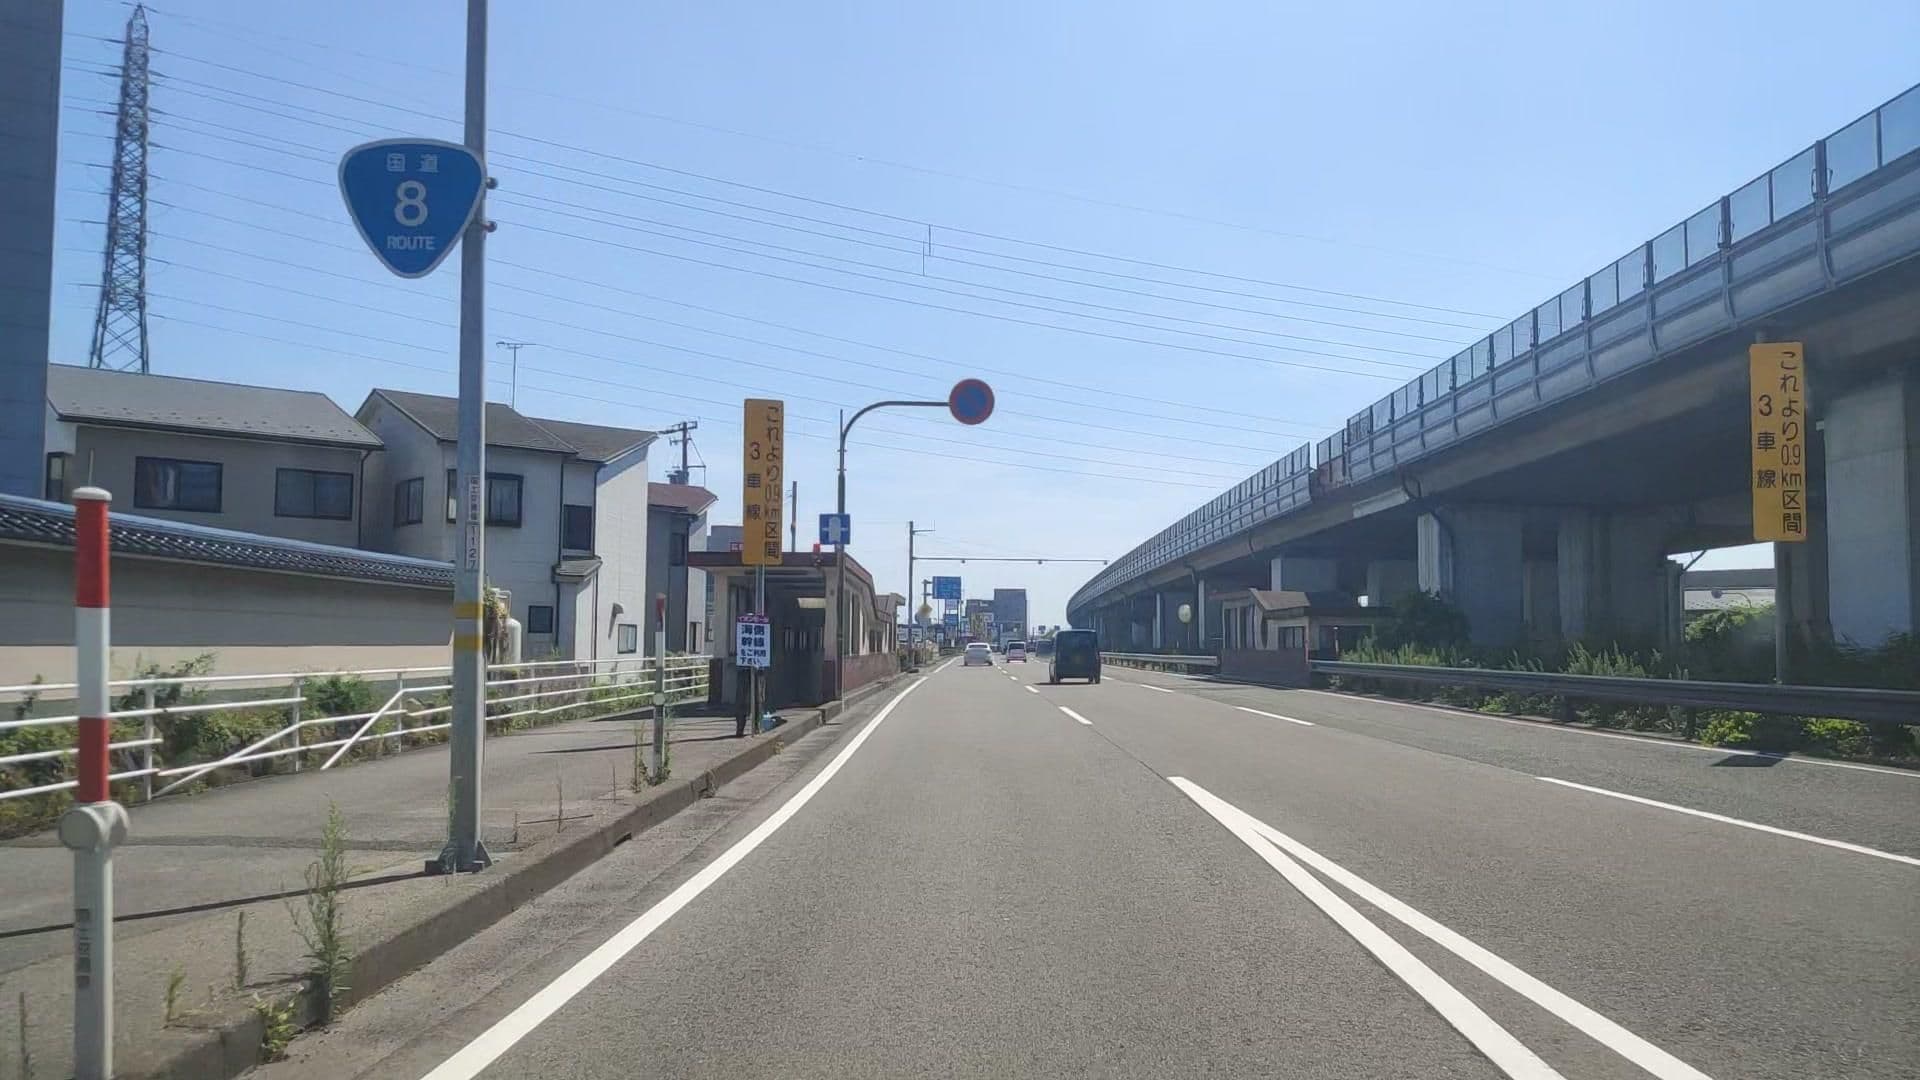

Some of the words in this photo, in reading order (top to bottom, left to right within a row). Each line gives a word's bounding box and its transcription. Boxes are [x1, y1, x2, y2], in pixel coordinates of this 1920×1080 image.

[386, 153, 439, 173] 国道
[394, 180, 428, 227] 8
[386, 235, 436, 250] ROUTE
[1757, 394, 1777, 489] 3車線
